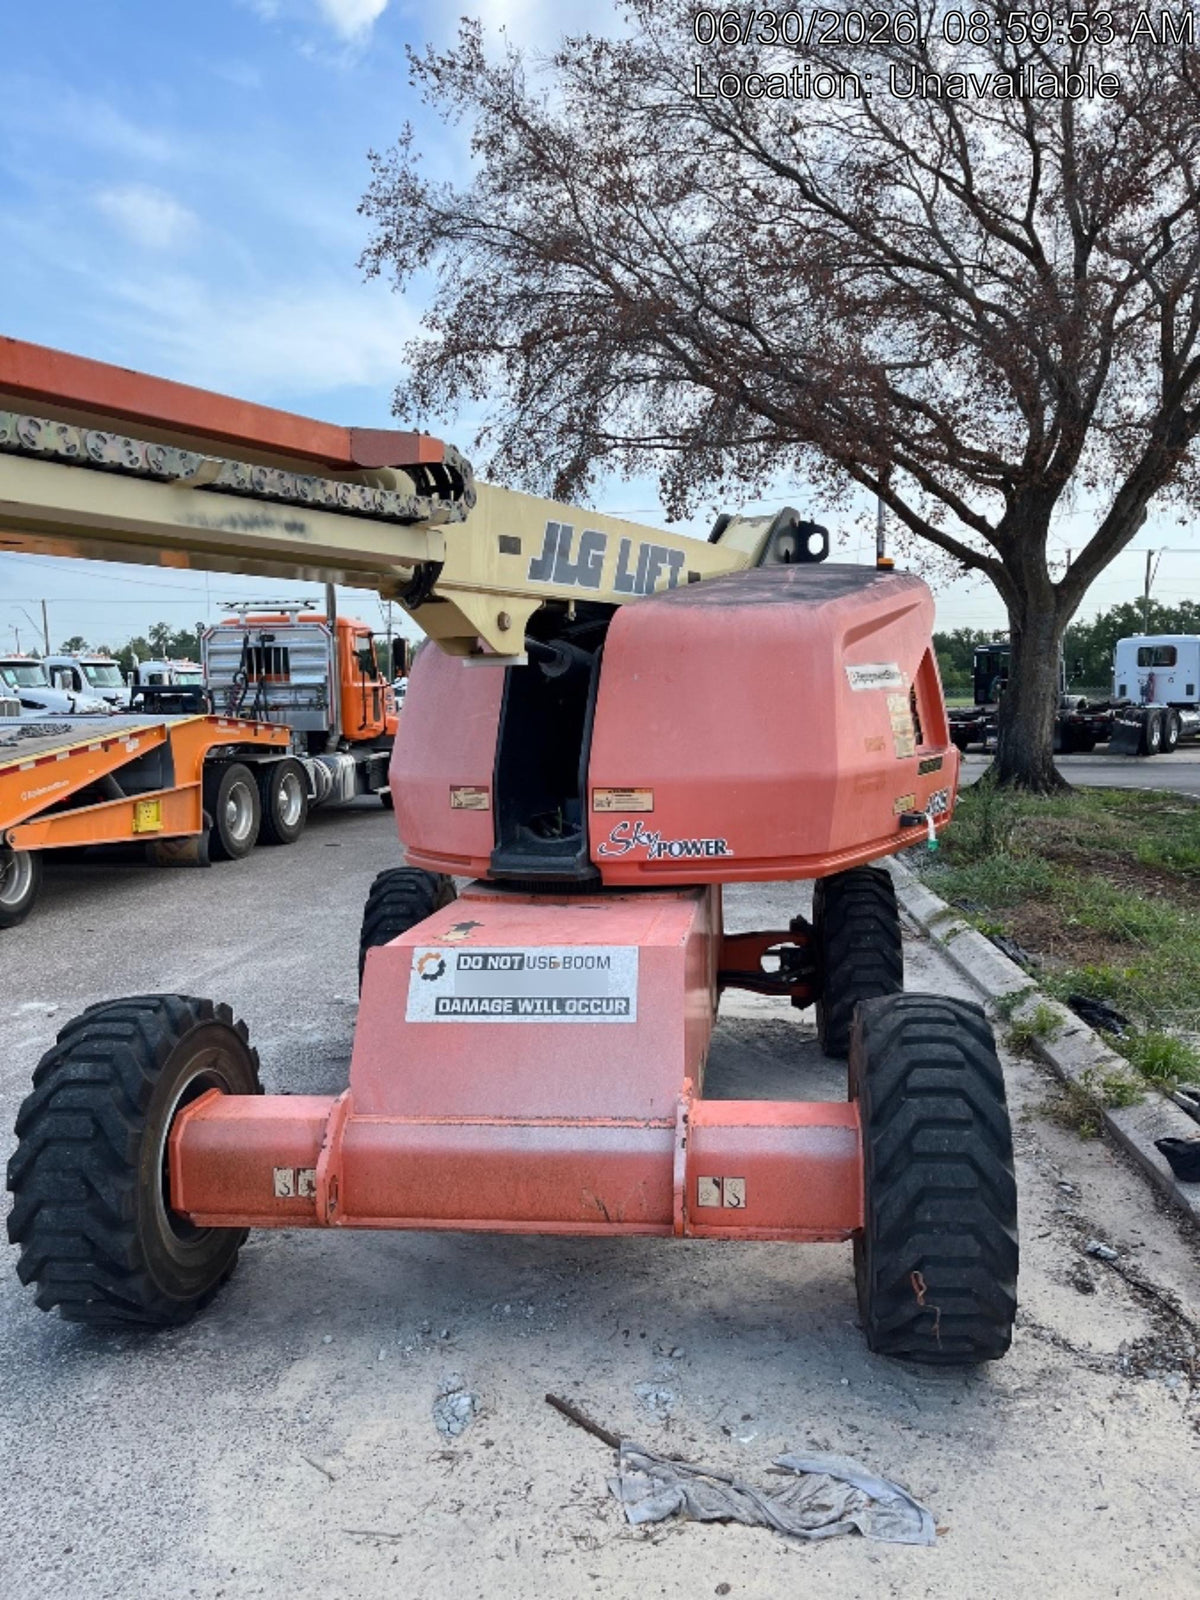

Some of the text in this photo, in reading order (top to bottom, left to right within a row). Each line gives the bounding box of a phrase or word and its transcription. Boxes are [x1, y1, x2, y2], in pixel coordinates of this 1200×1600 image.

[528, 520, 686, 596] JLG LIFT
[597, 821, 728, 861] Sky POWER
[459, 955, 611, 970] DO NOT USE BOOM
[438, 998, 627, 1014] DAMAGE WILL OCCUR
